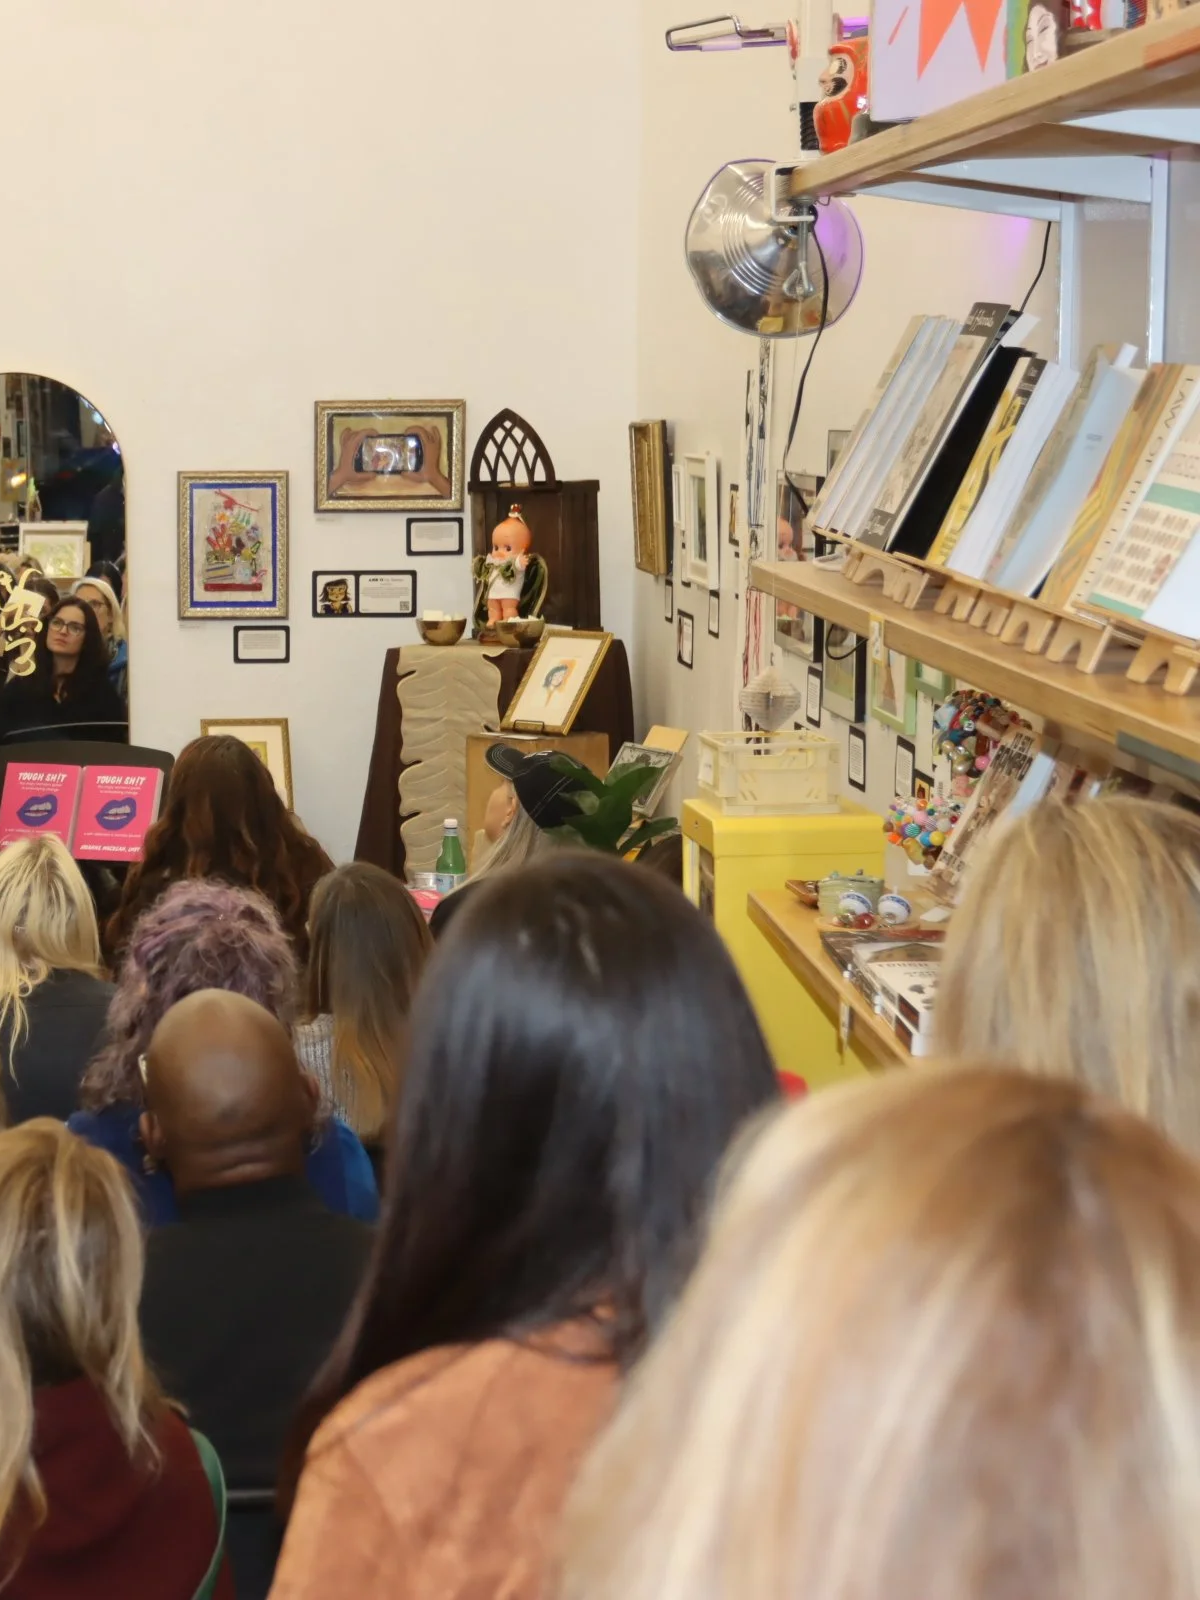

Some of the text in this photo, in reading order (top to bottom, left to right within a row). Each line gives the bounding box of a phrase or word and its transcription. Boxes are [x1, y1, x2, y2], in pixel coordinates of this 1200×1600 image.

[17, 772, 68, 784] TOUGH SH!T
[96, 775, 146, 787] TOUGH SH!T
